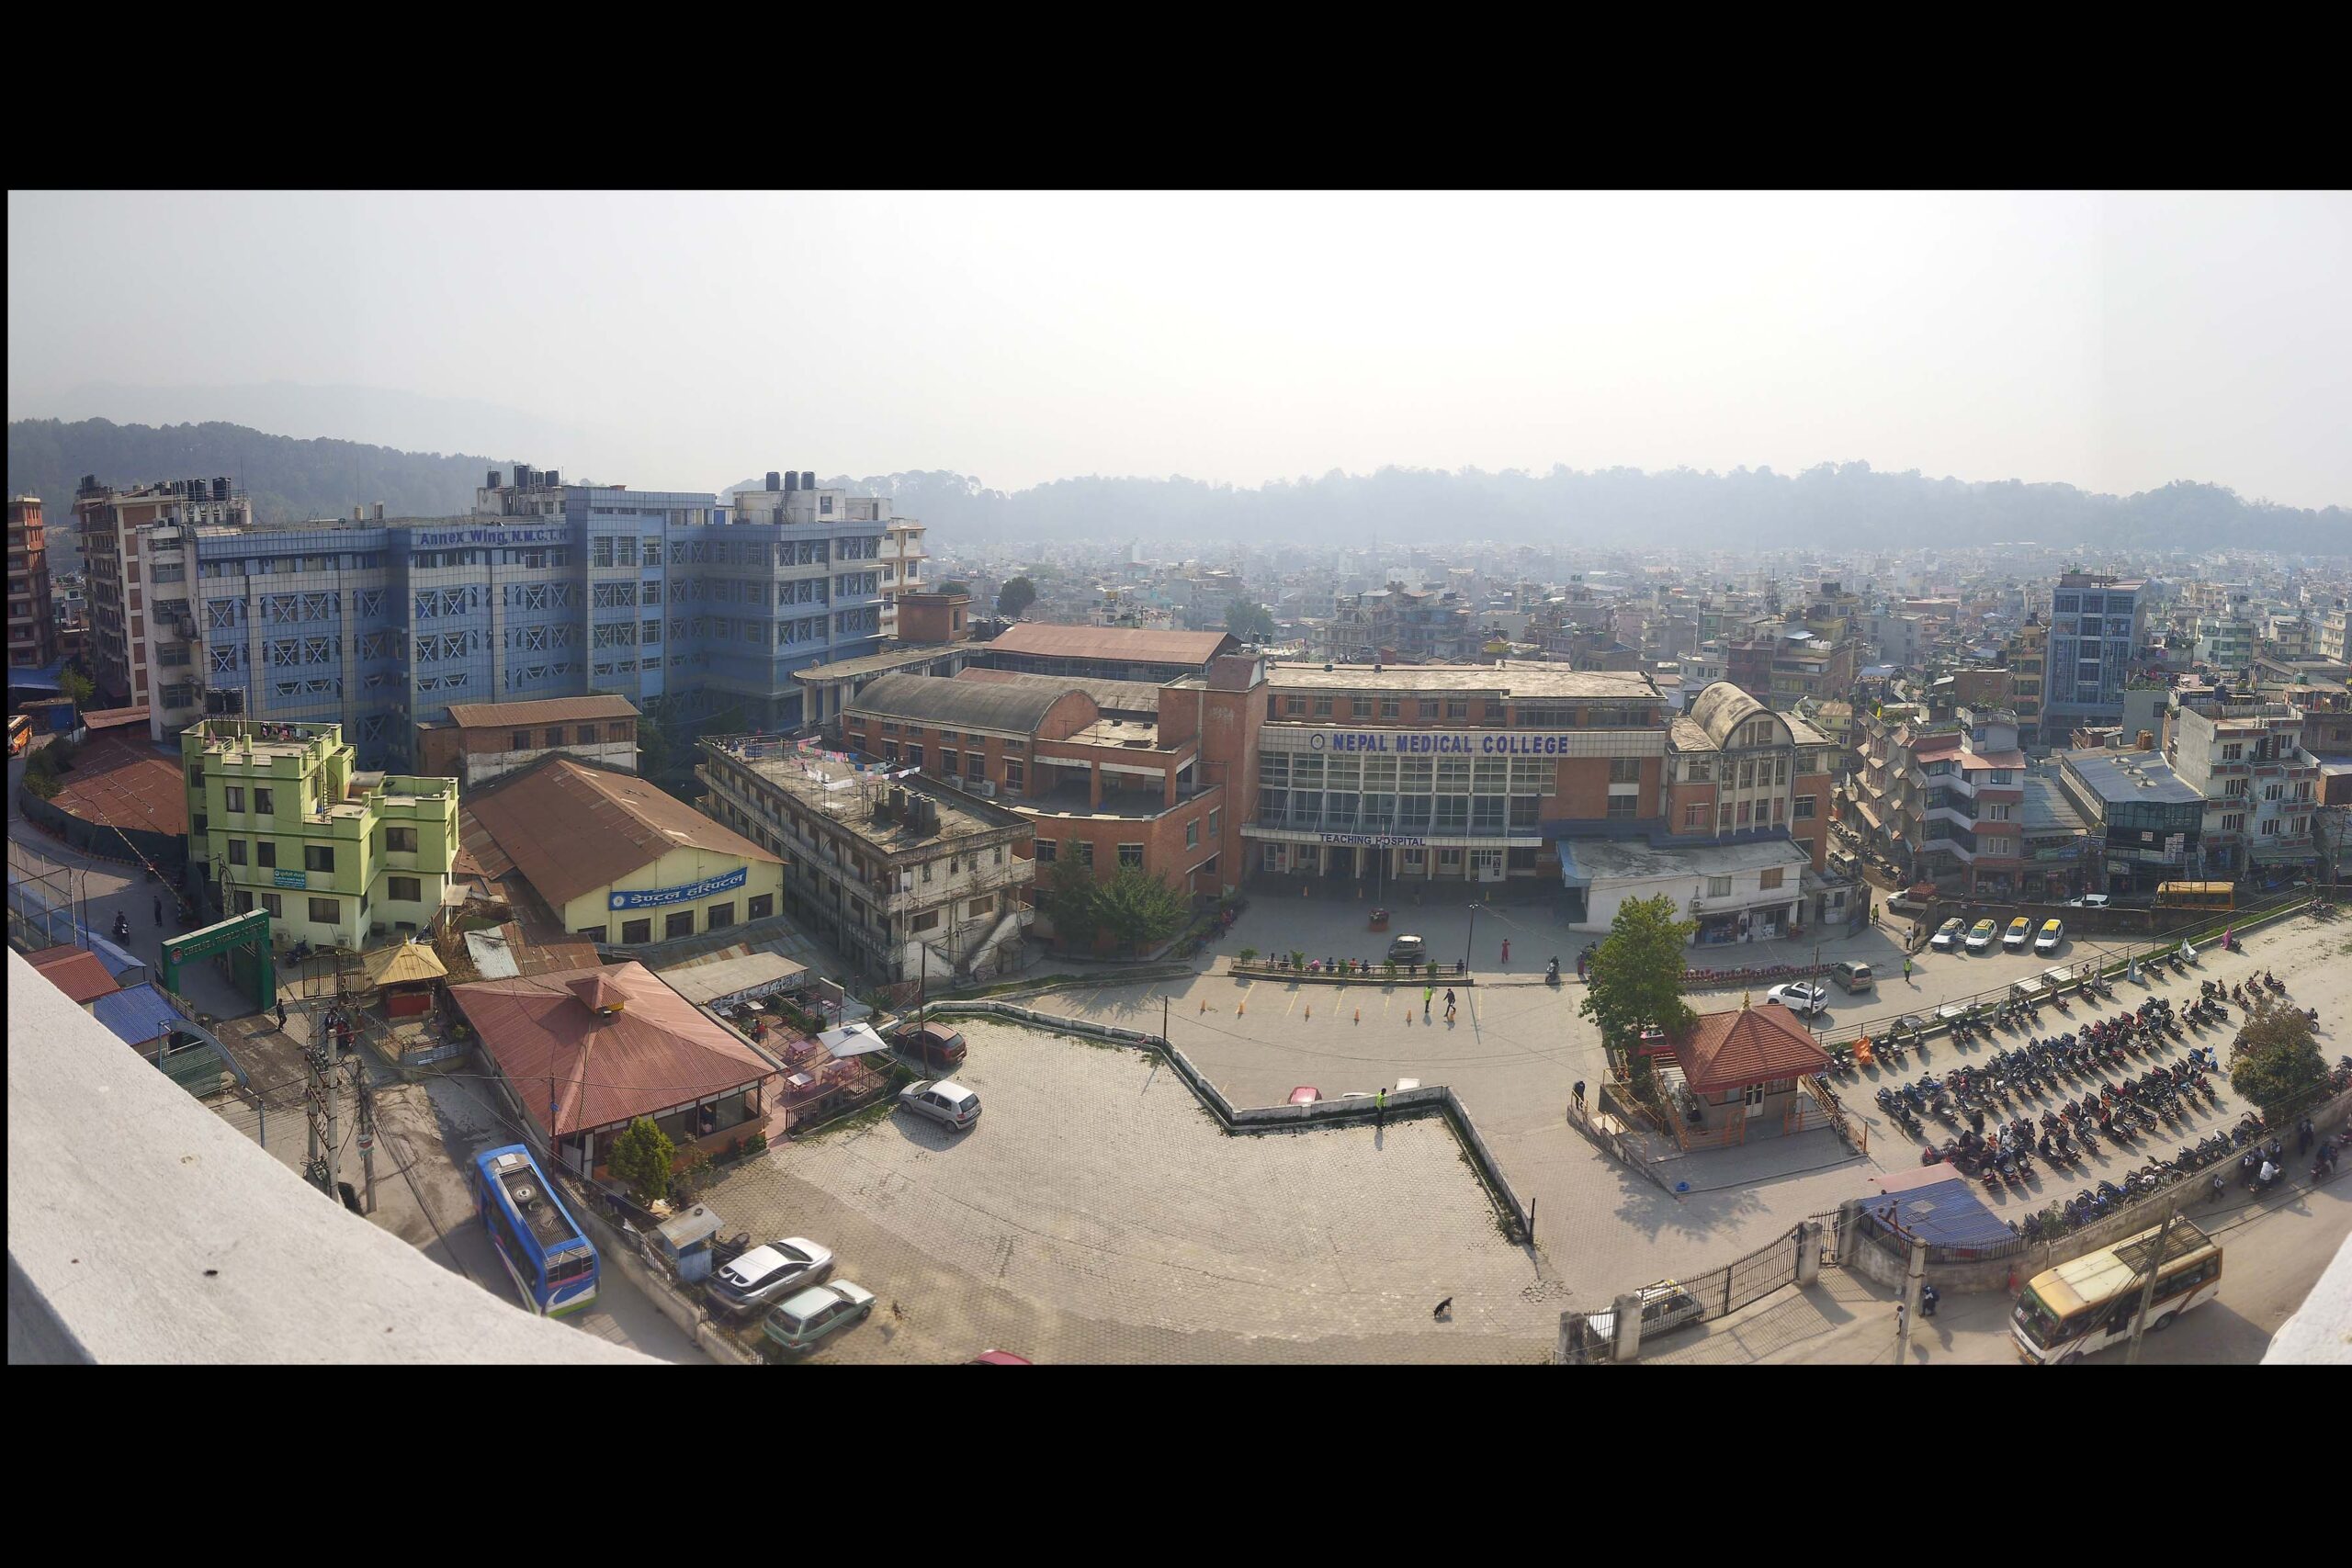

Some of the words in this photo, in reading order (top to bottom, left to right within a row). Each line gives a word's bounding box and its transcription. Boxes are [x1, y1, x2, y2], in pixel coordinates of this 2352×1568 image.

[421, 530, 463, 545] Annex
[1332, 734, 1388, 752] NEPAL
[1396, 735, 1473, 753] MEDICAL
[1482, 736, 1568, 754] COLLEGE
[1319, 833, 1372, 845] TEACHING
[1375, 835, 1426, 846] HOSPITAL
